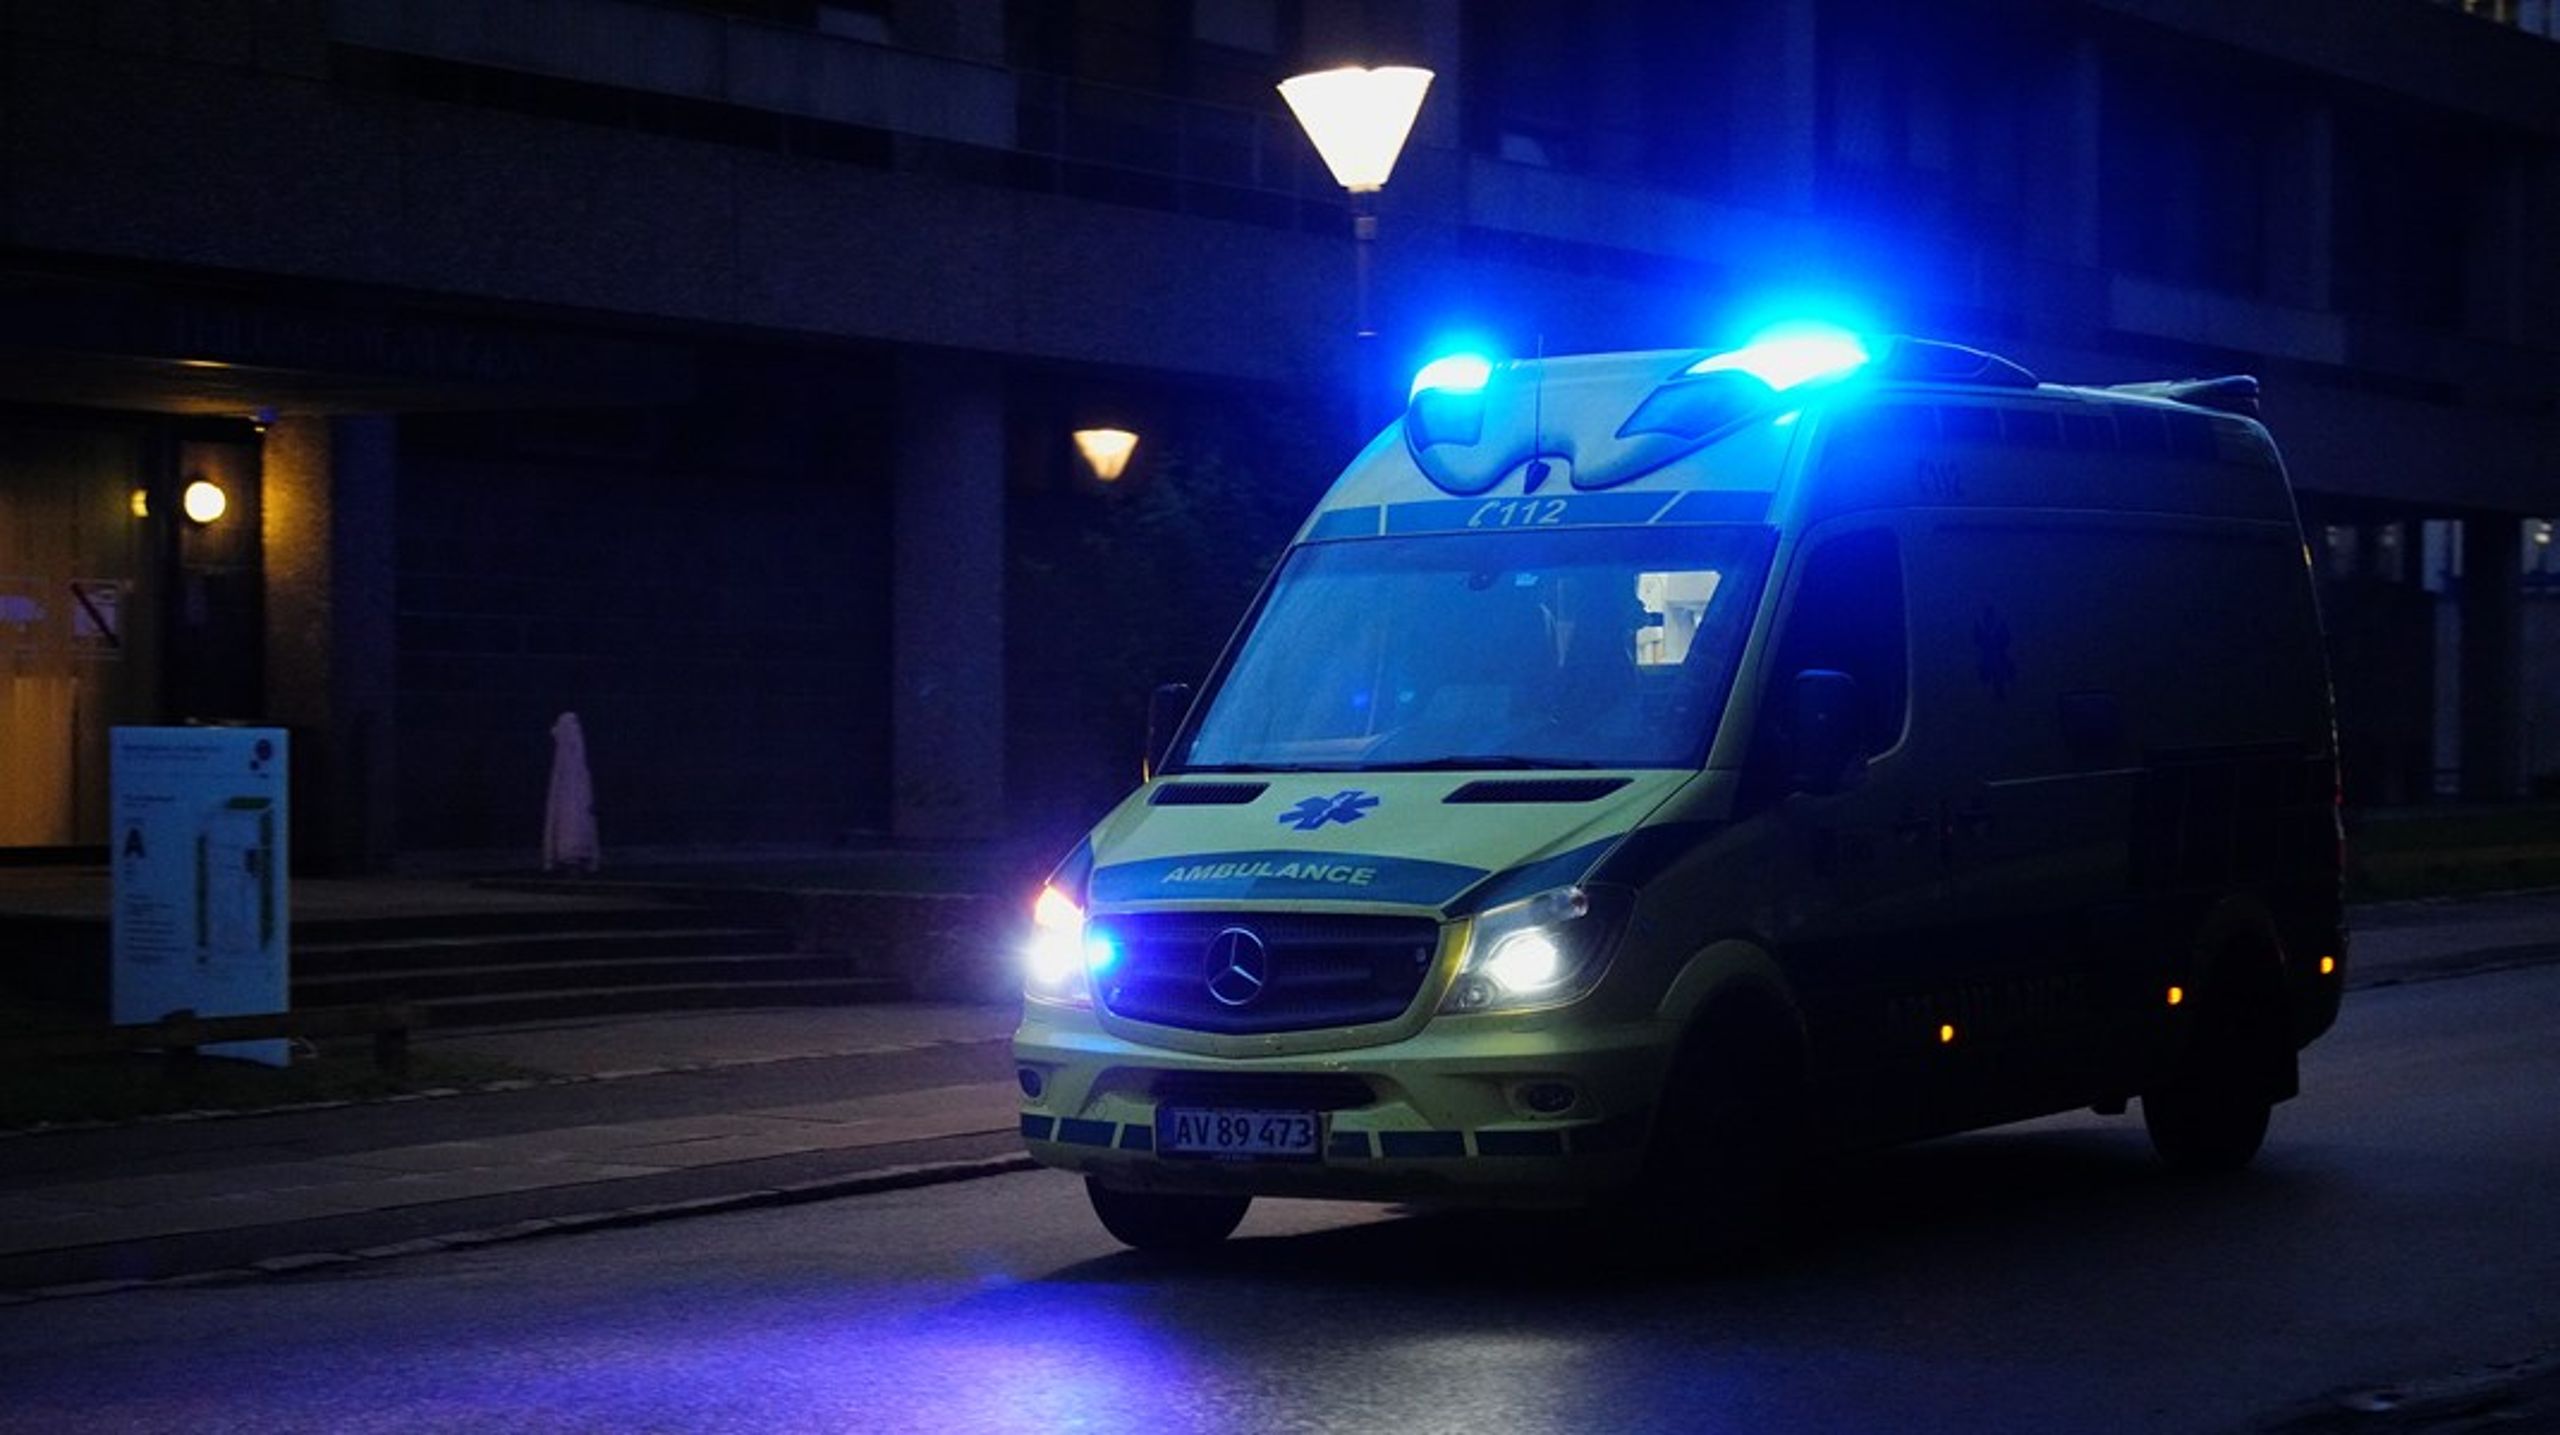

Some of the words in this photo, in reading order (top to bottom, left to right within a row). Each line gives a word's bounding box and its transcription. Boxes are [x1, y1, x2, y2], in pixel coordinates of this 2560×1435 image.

[1500, 499, 1568, 526] 112
[124, 828, 146, 859] A
[1161, 861, 1377, 887] AMBULANCE
[1176, 1115, 1210, 1145] AV
[1217, 1115, 1251, 1146] 89
[1259, 1117, 1313, 1148] 473
